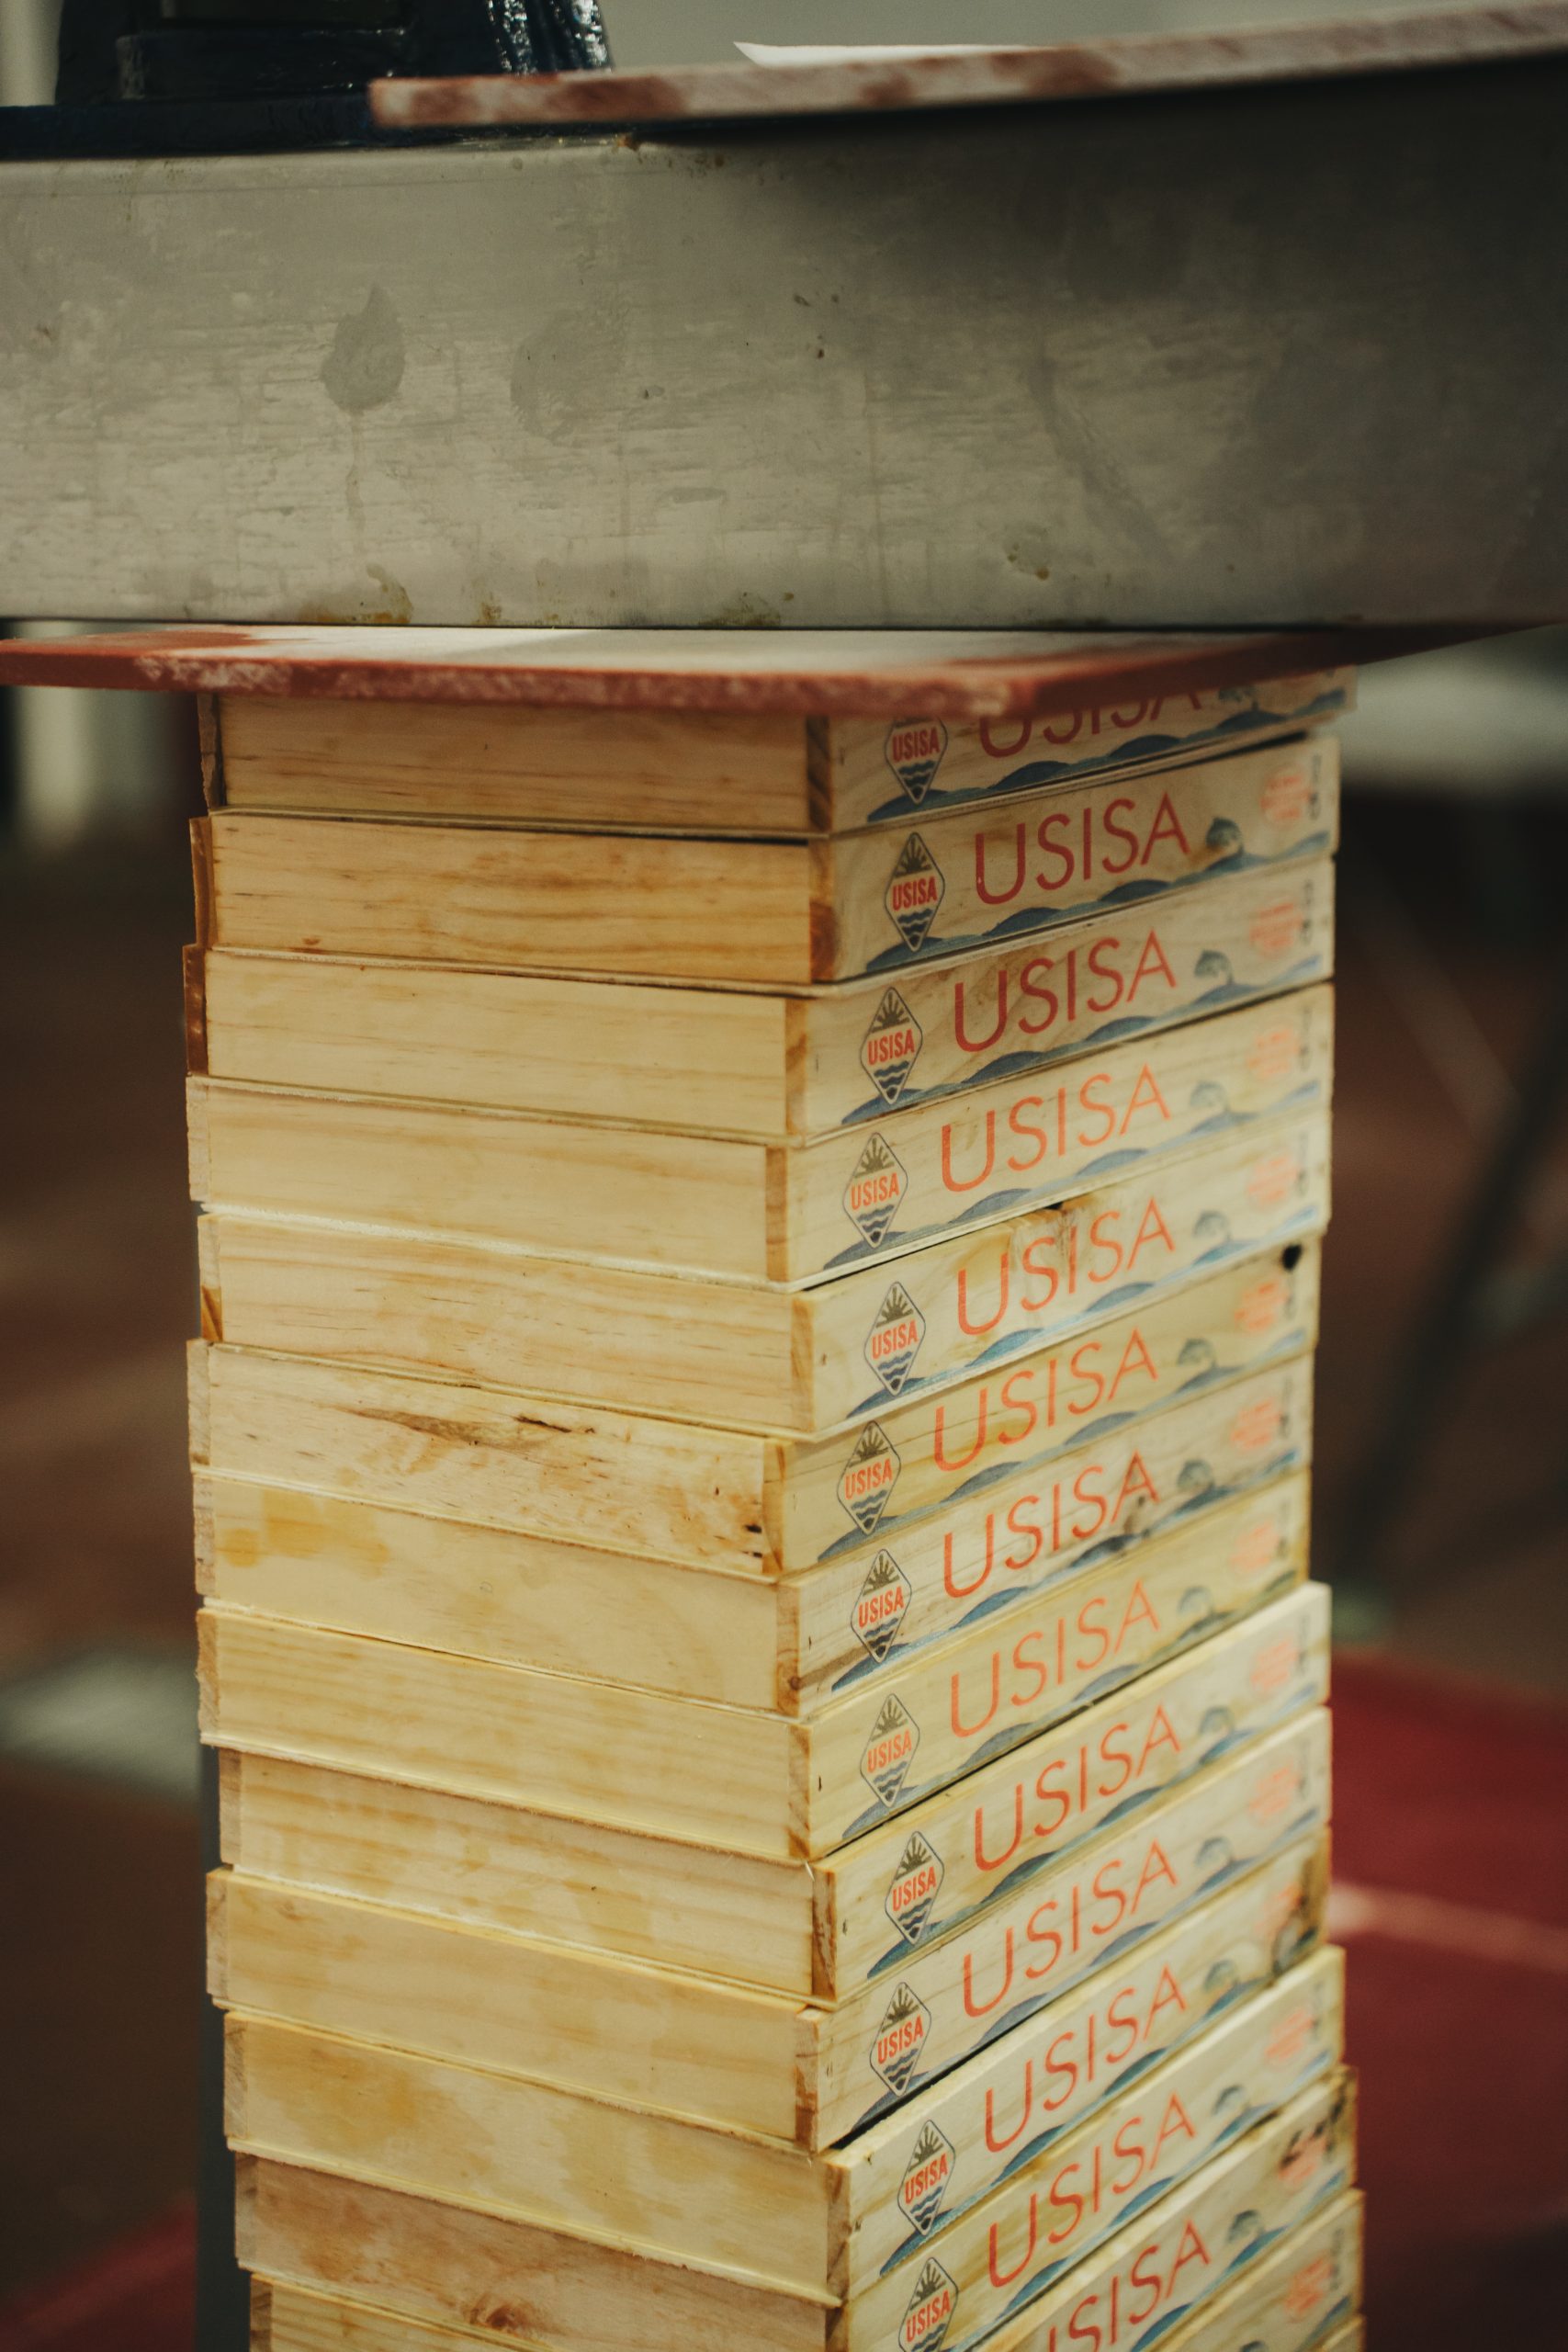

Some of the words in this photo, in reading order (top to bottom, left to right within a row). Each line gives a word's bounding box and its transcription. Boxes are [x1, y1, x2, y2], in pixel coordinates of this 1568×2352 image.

[892, 727, 941, 760] USISA
[976, 793, 1191, 905] USISA
[892, 876, 937, 909] USISA
[954, 930, 1177, 1053] USISA
[868, 1030, 915, 1064] USISA
[942, 1065, 1171, 1192] USISA
[851, 1172, 900, 1210] USISA
[958, 1197, 1176, 1335] USISA
[872, 1320, 919, 1360] USISA
[934, 1329, 1157, 1472] USISA
[845, 1459, 893, 1500] USISA
[943, 1450, 1157, 1598] USISA
[859, 1586, 904, 1627] USISA
[951, 1579, 1159, 1738] USISA
[868, 1729, 912, 1773] USISA
[975, 1704, 1181, 1871] USISA
[892, 1866, 936, 1912] USISA
[963, 1838, 1179, 2018] USISA
[877, 2016, 924, 2063] USISA
[985, 1964, 1188, 2153] USISA
[904, 2154, 948, 2204] USISA
[989, 2093, 1196, 2288] USISA
[907, 2291, 951, 2343] USISA
[1048, 2218, 1211, 2352] SISA
